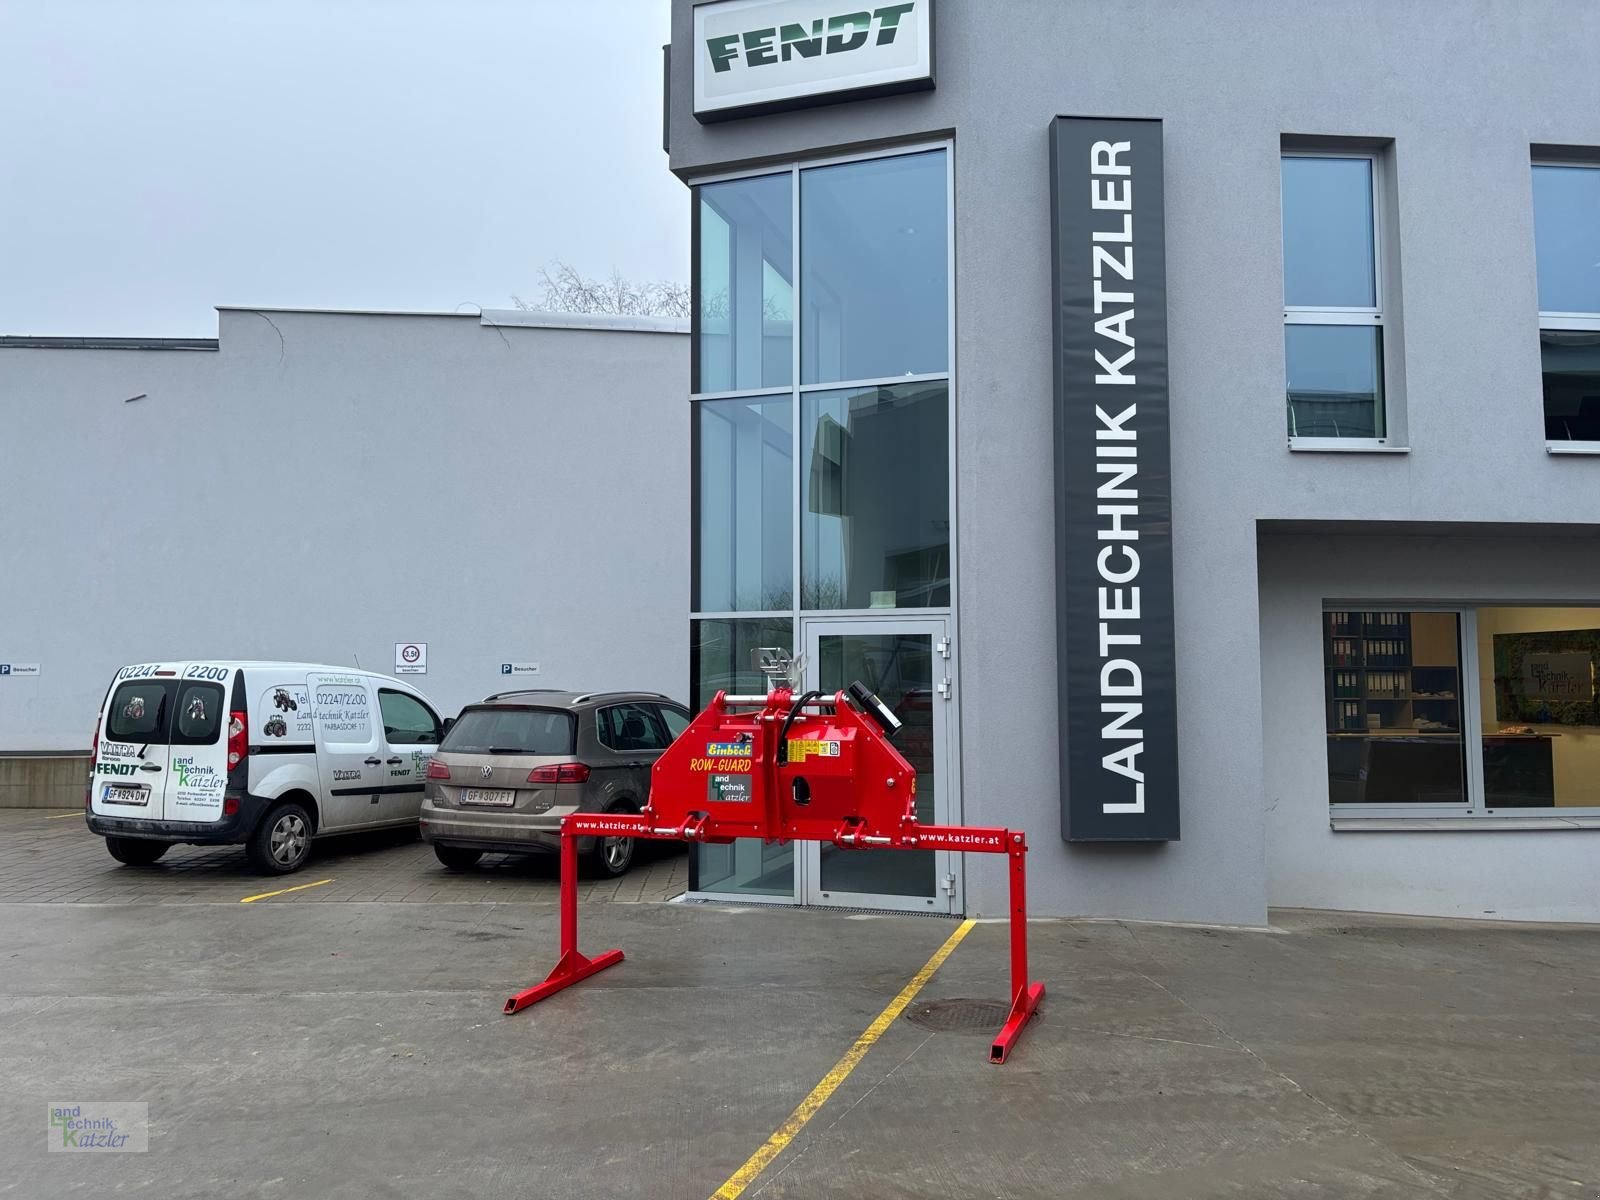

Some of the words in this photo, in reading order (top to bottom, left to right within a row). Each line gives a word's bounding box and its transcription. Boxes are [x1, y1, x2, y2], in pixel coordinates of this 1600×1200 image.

[706, 2, 915, 73] FENDT
[1090, 140, 1138, 386] KATZLER
[1095, 403, 1146, 815] LANDTECHNIK
[119, 665, 160, 680] 02247
[187, 665, 229, 681] 2200
[316, 693, 367, 706] 02247/2200
[343, 710, 369, 721] Katzler
[100, 741, 136, 757] VALTRA
[708, 743, 752, 756] Einböck
[97, 763, 140, 776] FENDT
[173, 757, 194, 772] Land
[178, 764, 214, 777] Technik
[690, 758, 752, 772] ROW-GUARD
[333, 770, 361, 781] VALTRA
[390, 769, 411, 777] FENDT
[179, 773, 225, 788] Katzler
[717, 790, 751, 801] Katzler
[576, 821, 641, 831] www.katzler.at
[920, 833, 999, 845] www.katzler.at
